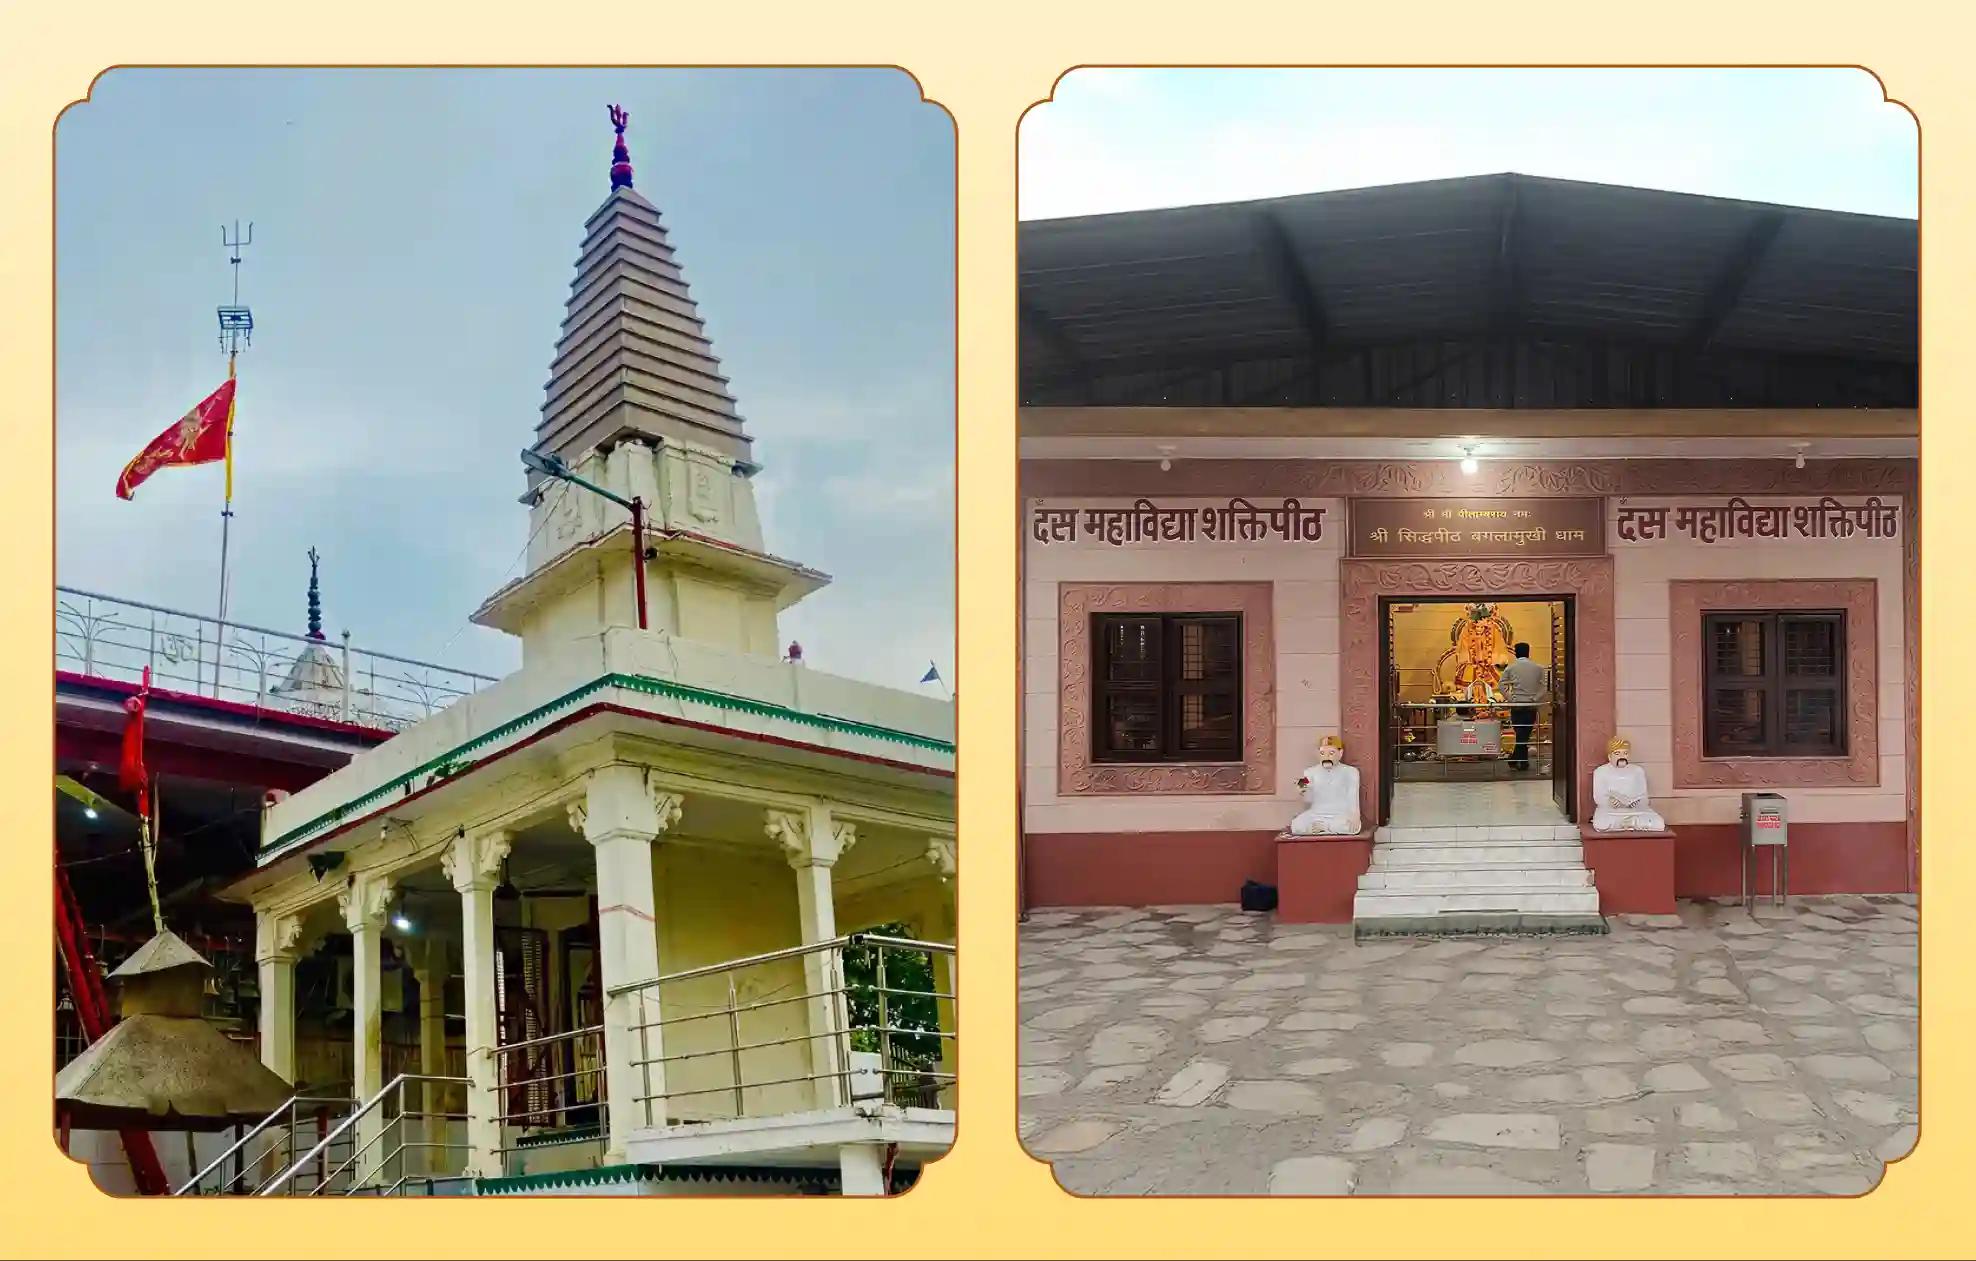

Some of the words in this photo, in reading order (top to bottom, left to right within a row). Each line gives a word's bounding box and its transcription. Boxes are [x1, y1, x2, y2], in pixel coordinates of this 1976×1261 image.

[1033, 508, 1080, 545] दस
[1084, 498, 1199, 546] महाविद्या
[1201, 497, 1327, 542] शक्तिपीठ
[1369, 528, 1388, 544] श्री
[1399, 528, 1462, 544] सिद्धपीठ
[1471, 527, 1546, 546] बगलामुखी
[1555, 530, 1585, 541] धाम
[1617, 507, 1671, 542] दस
[1675, 497, 1792, 543] महाविद्या
[1794, 496, 1900, 538] शक्तिपीठ
